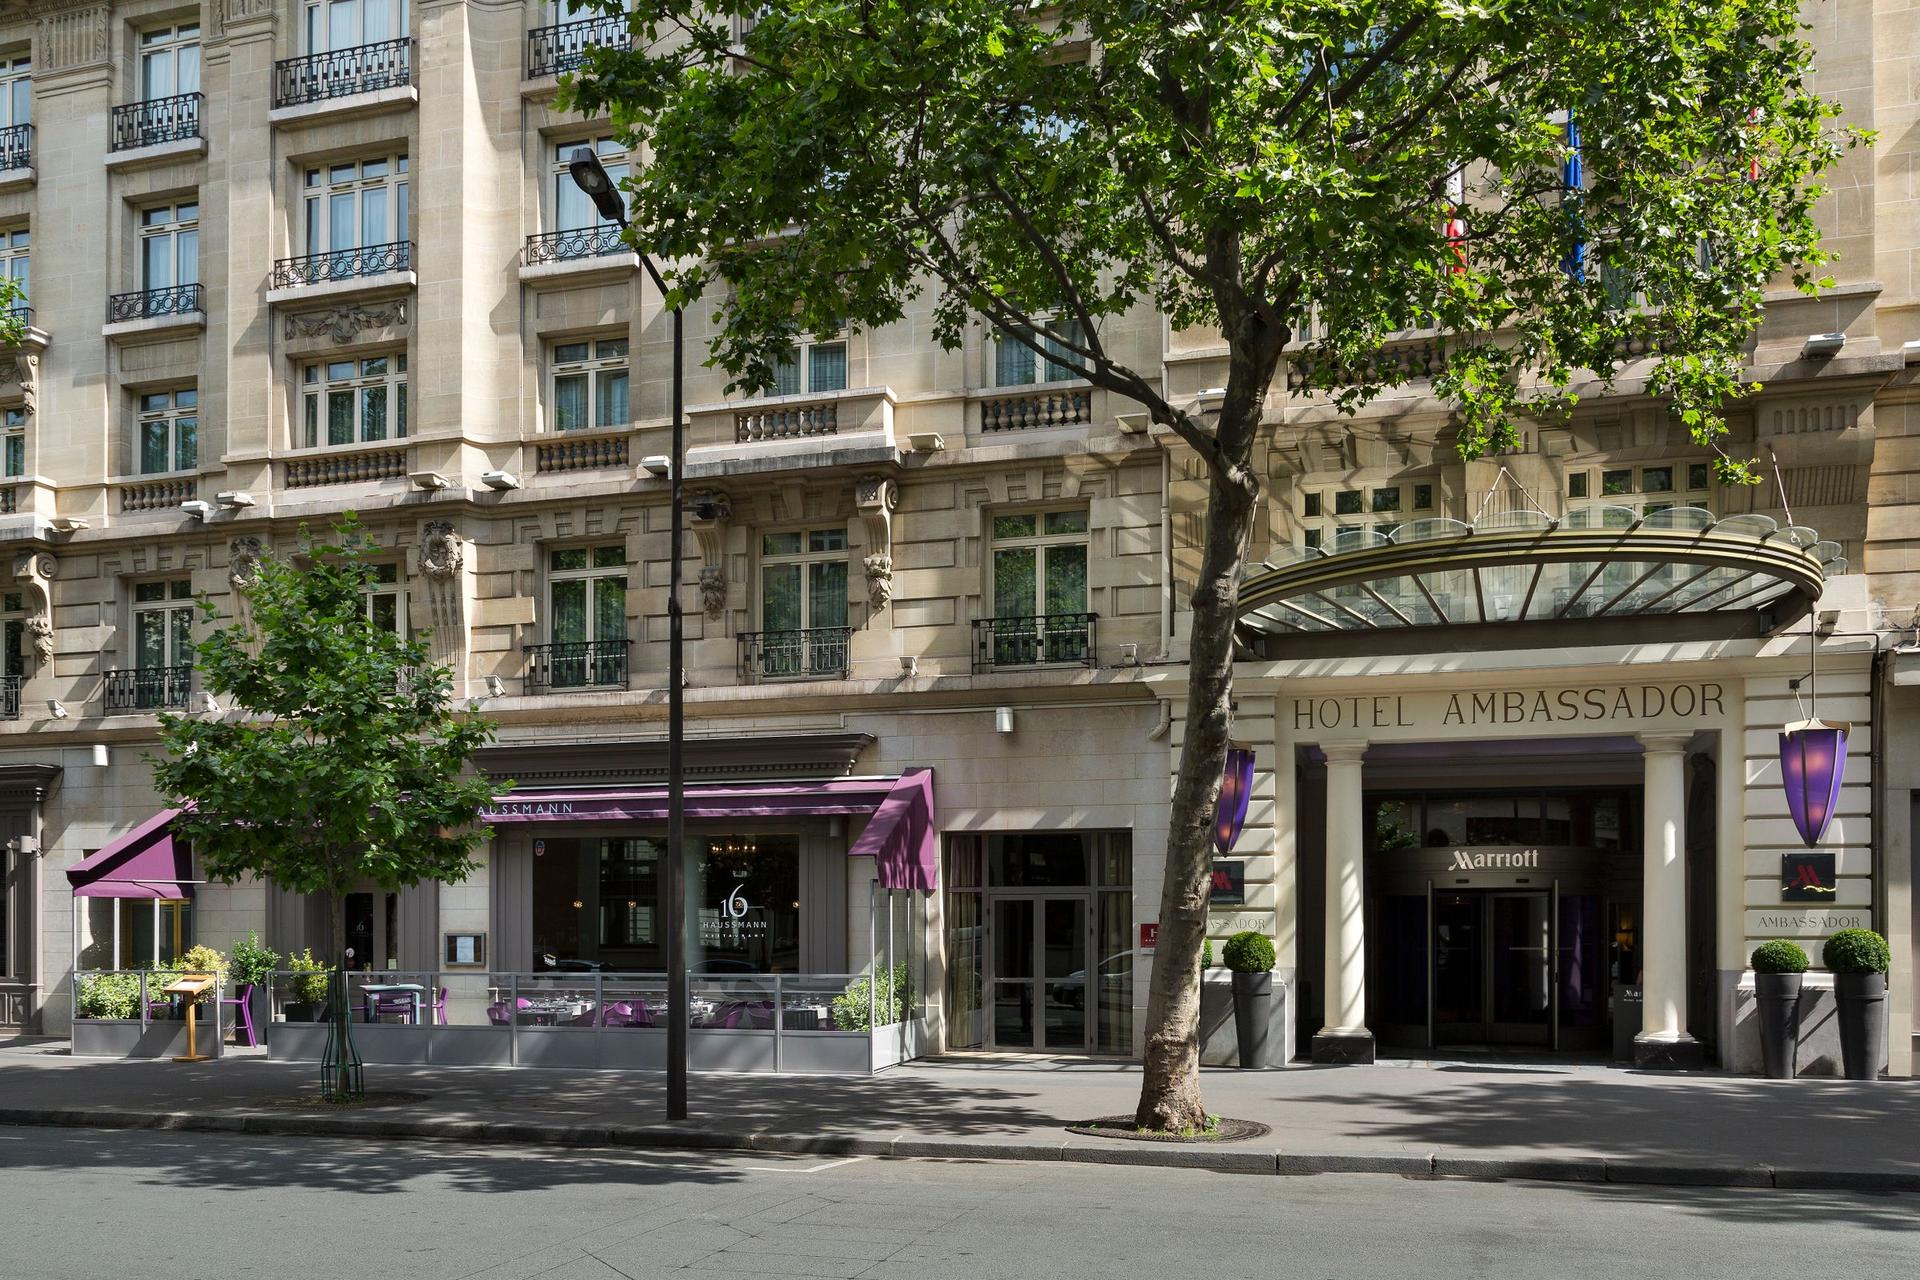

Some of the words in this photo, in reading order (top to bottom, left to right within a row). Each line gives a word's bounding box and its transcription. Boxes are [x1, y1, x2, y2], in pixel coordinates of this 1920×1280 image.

[1294, 695, 1415, 730] HOTEL
[1442, 683, 1725, 725] AMBASSADOR
[477, 803, 573, 815] AUSSMANN
[1448, 849, 1540, 871] Marriott
[720, 883, 749, 918] 16
[703, 921, 767, 929] HAUSSMANN
[1207, 918, 1266, 929] ASSADOR
[1758, 916, 1861, 928] AMBASSADOR
